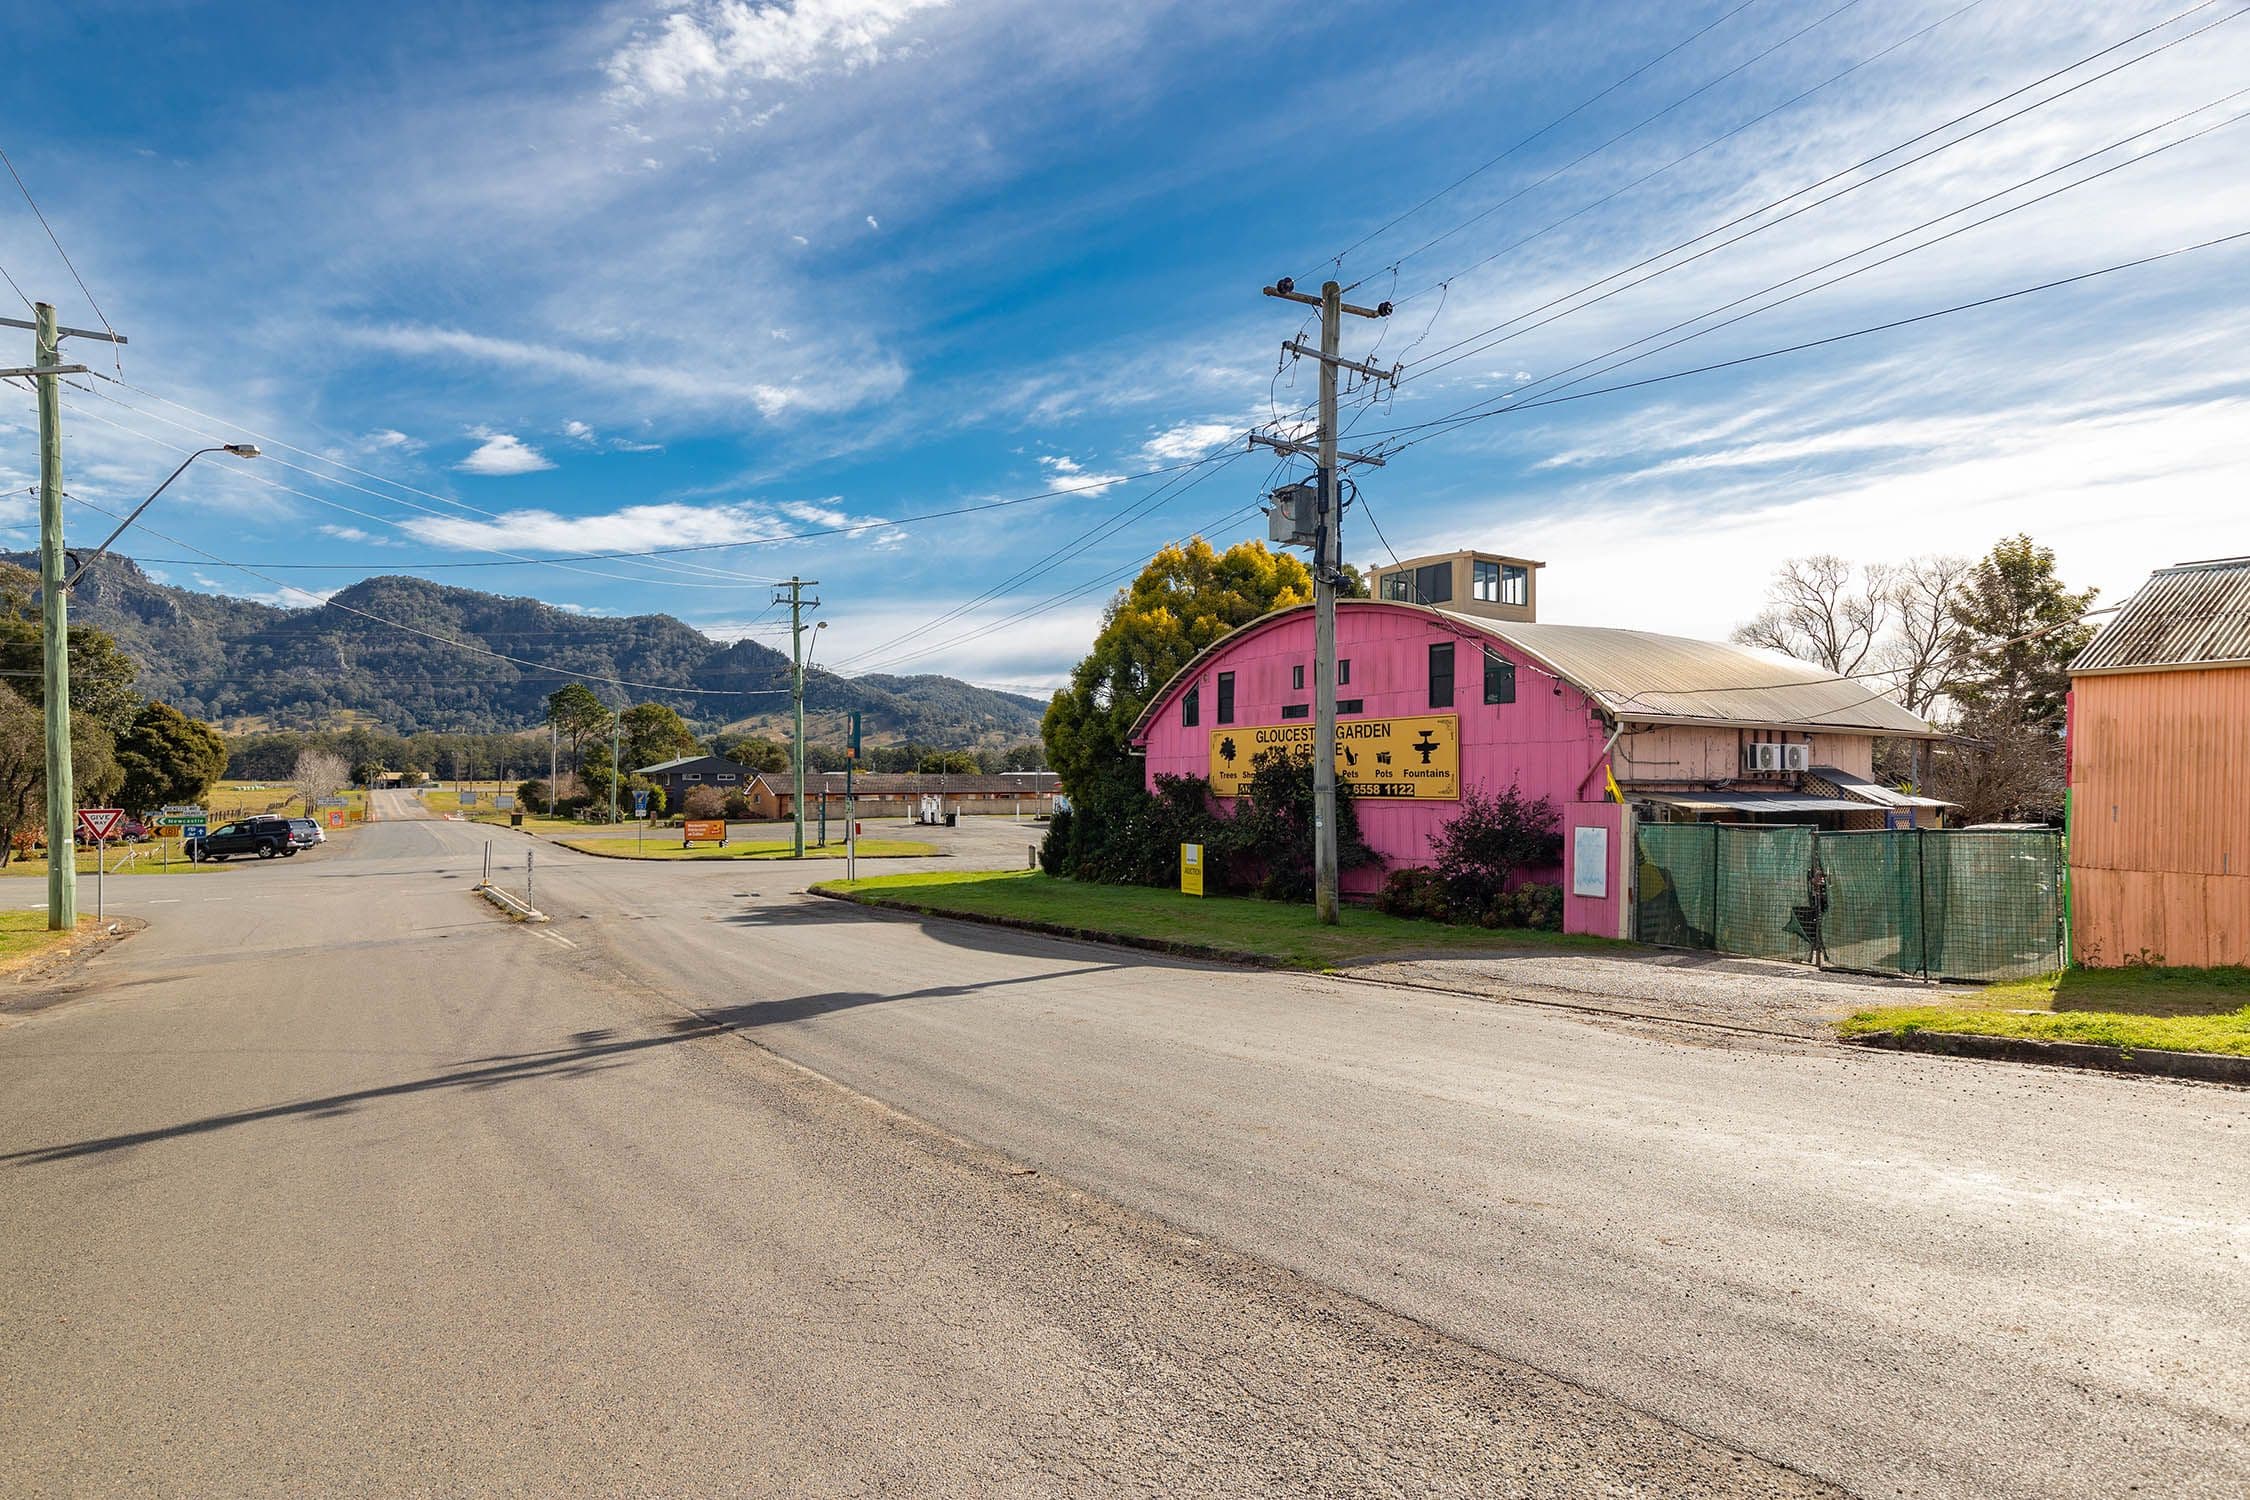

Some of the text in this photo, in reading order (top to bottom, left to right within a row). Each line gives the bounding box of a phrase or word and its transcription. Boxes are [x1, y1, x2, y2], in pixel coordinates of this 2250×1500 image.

[1255, 723, 1391, 743] GLOUCEST GARDEN
[1294, 742, 1343, 757] CENE
[1219, 771, 1238, 779] Trees
[1342, 769, 1359, 778] Pets
[1375, 769, 1393, 778] Pots
[1403, 768, 1450, 778] Fountains
[1353, 784, 1414, 795] 6558 1122
